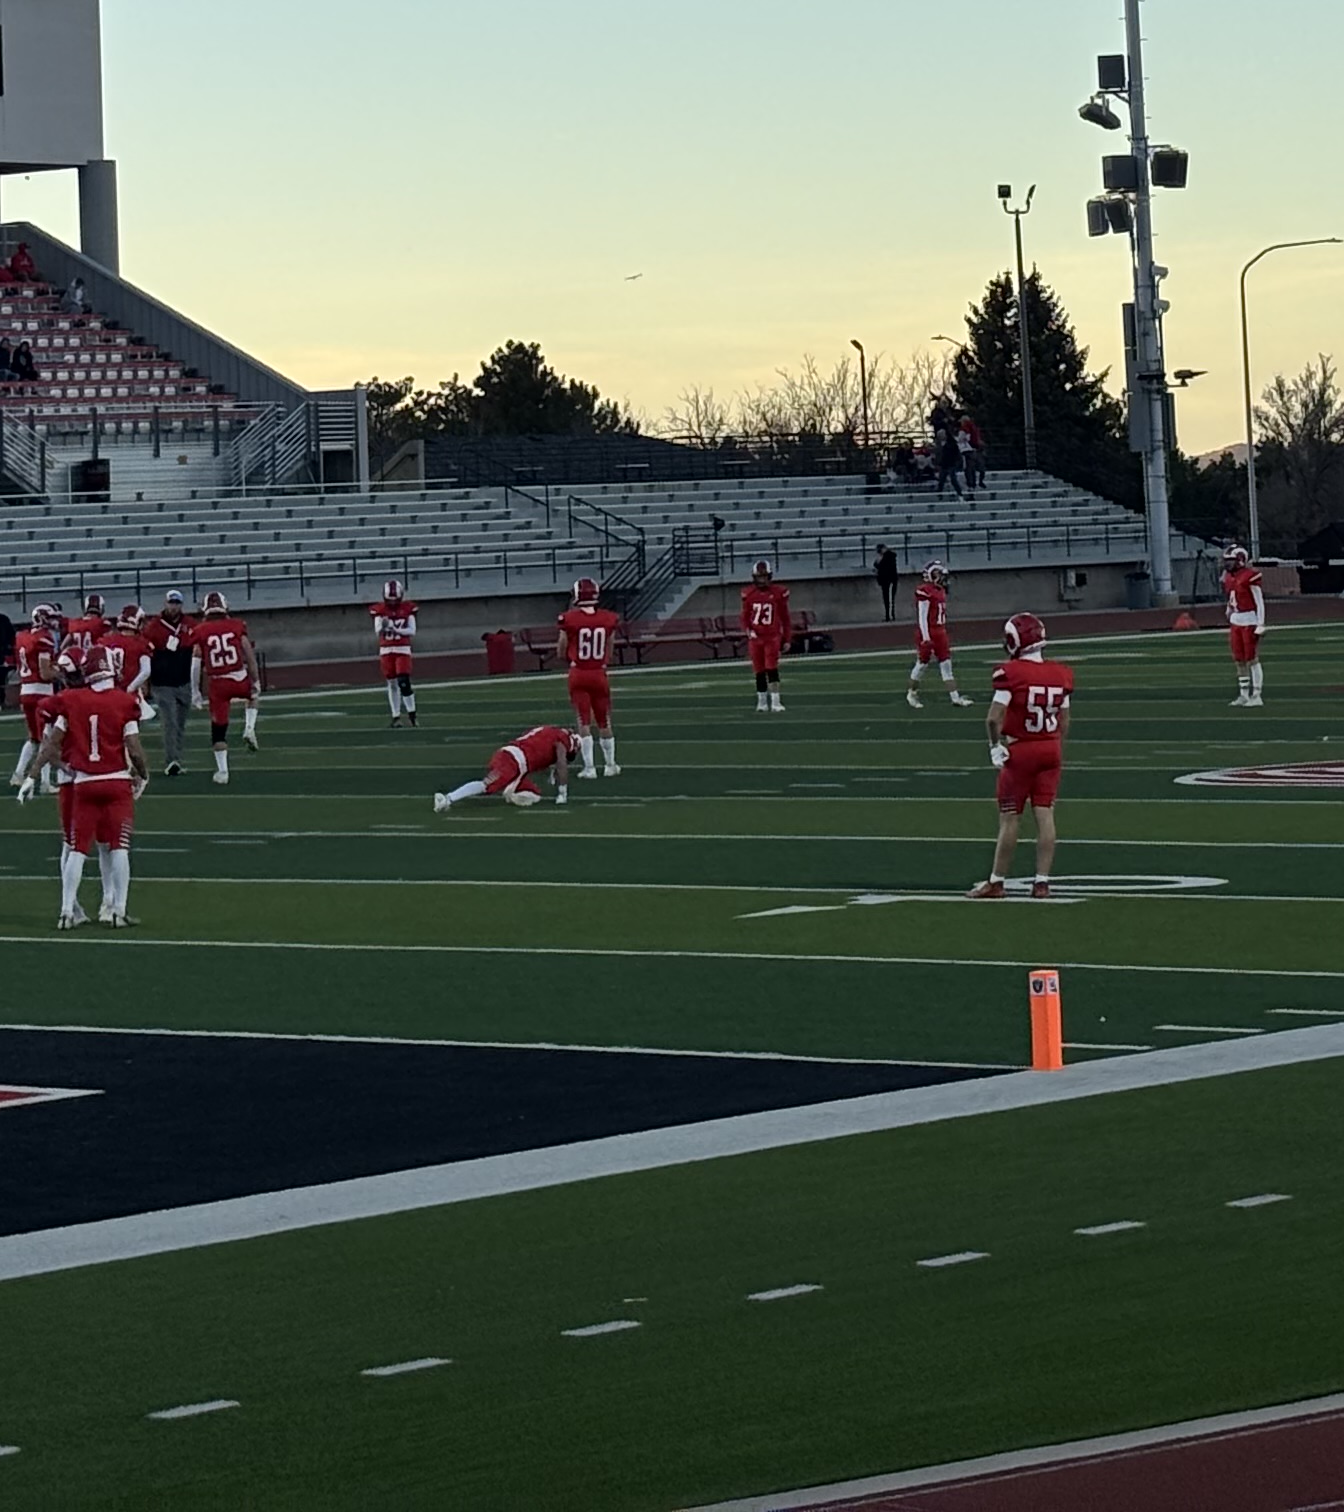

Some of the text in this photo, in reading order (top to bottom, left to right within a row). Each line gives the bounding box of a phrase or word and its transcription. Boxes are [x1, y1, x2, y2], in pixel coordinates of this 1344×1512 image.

[752, 603, 773, 626] 73
[207, 632, 238, 668] 25
[578, 627, 607, 660] 60
[1025, 685, 1064, 733] 55
[89, 714, 101, 762] 1
